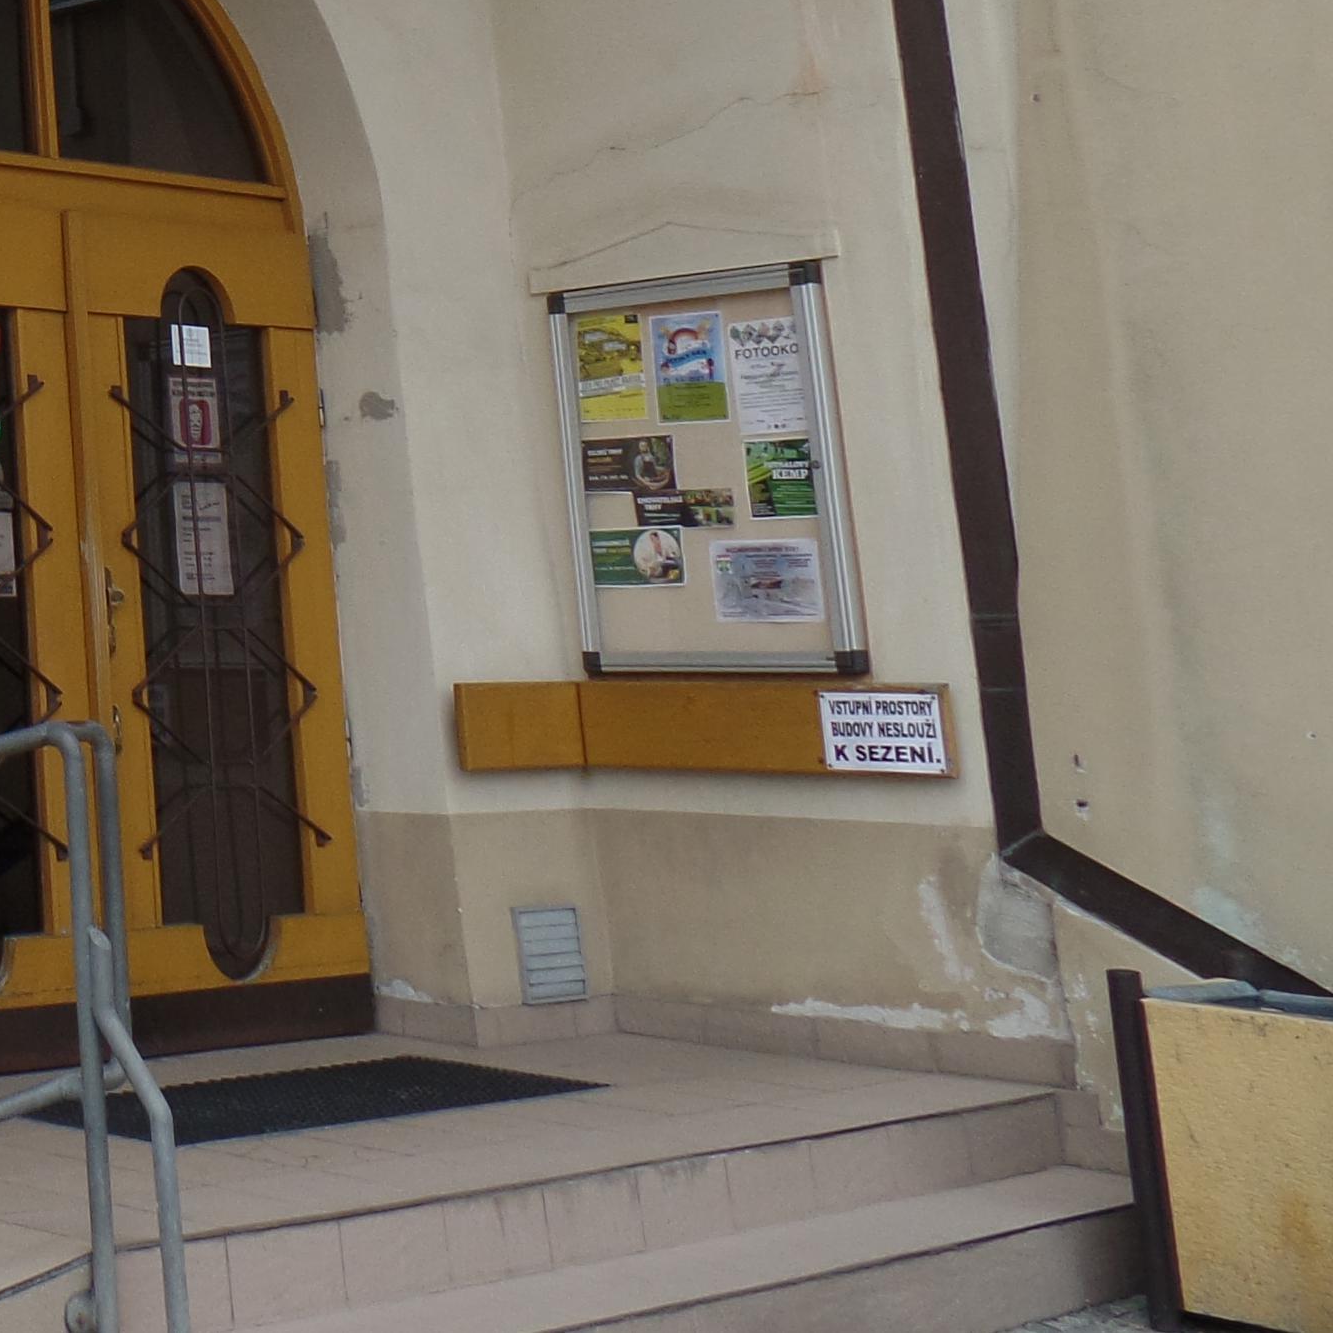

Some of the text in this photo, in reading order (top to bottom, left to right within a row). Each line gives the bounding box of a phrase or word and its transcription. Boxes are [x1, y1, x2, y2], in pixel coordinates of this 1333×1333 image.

[734, 343, 799, 359] FOTOOKO
[772, 469, 809, 480] KEMP
[828, 696, 932, 716] VSTUPNÍ PROSTORY
[831, 719, 937, 738] BUDOVY NESLOUŽÍ
[834, 742, 942, 764] K SEZENÍ.
